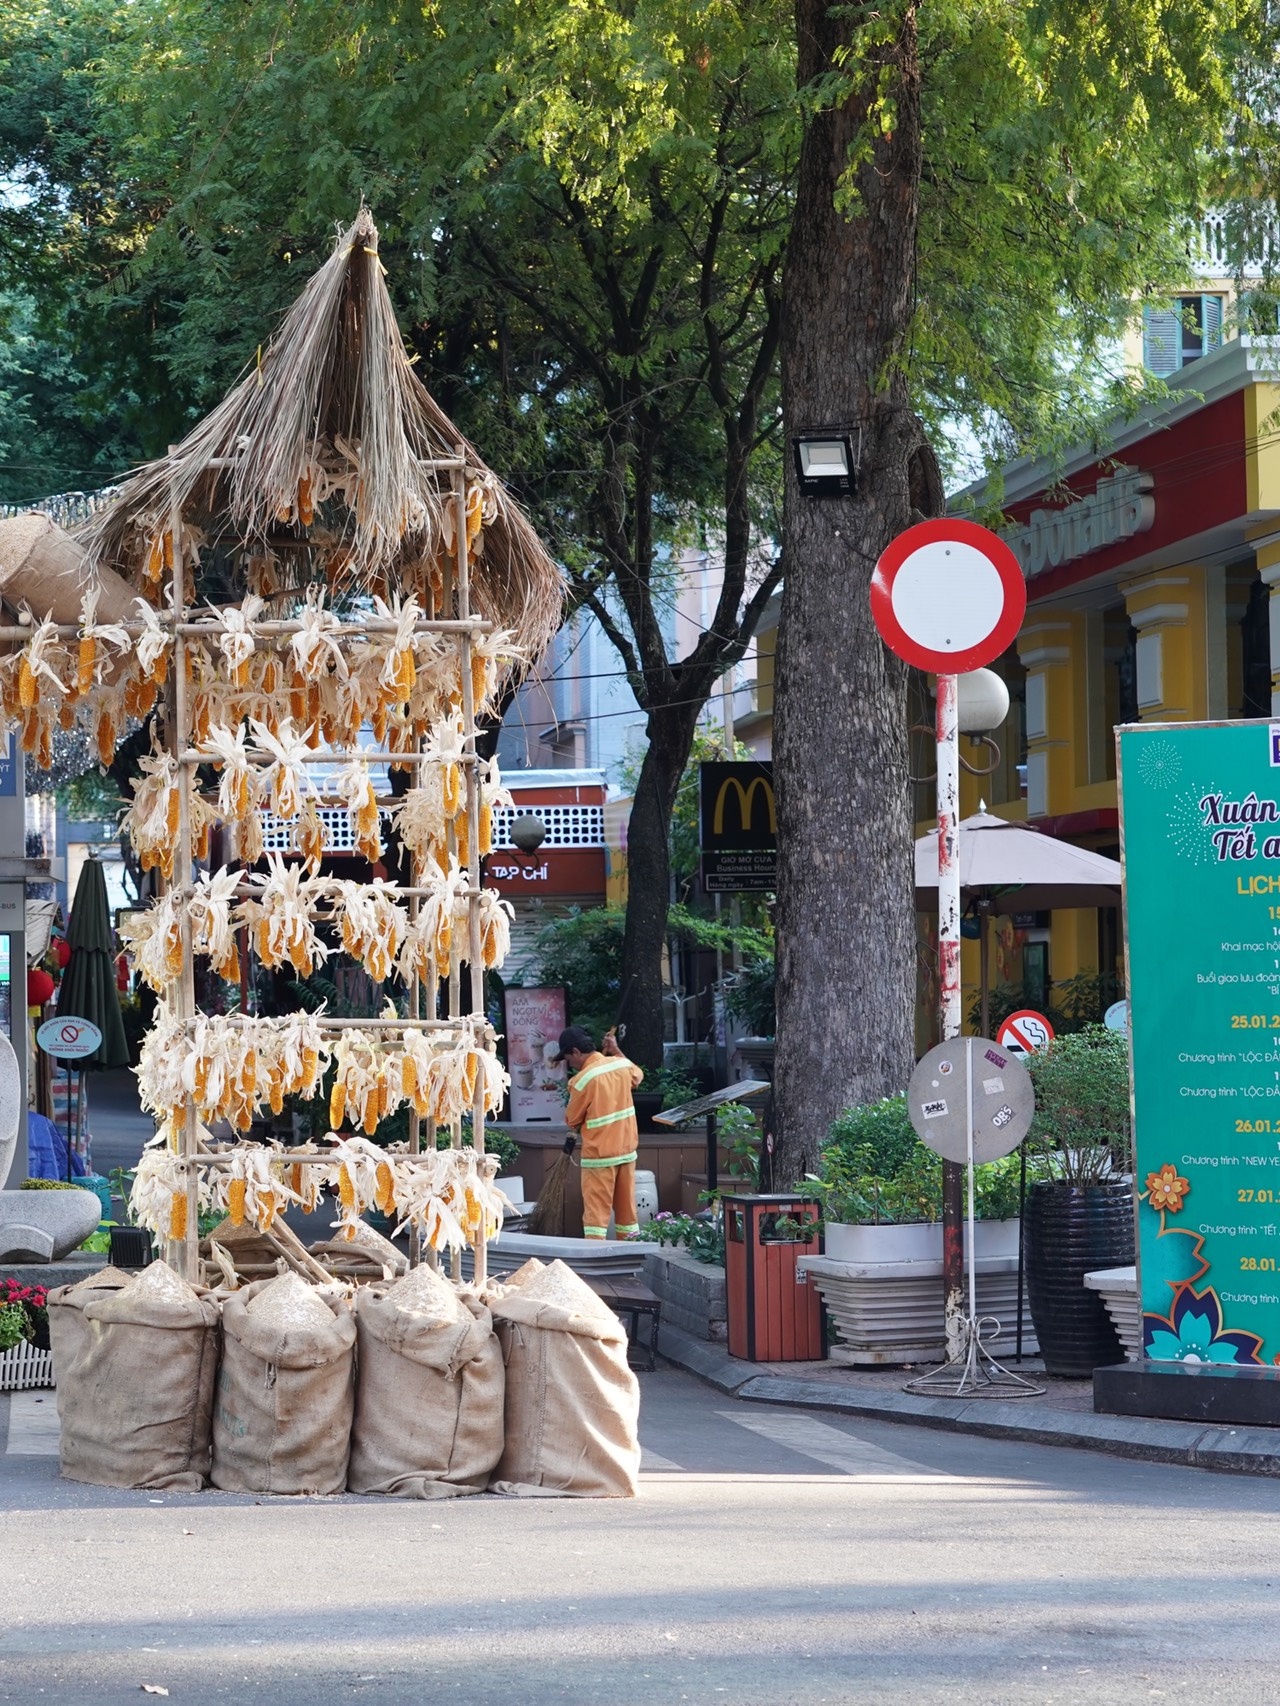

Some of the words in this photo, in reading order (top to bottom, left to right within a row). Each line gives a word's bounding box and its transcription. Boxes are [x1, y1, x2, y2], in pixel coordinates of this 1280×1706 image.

[1199, 791, 1280, 826] Xuân
[1212, 824, 1259, 862] Tết
[522, 862, 549, 880] CHÍ
[1221, 942, 1241, 952] Khai
[1243, 942, 1265, 952] mạc
[1197, 971, 1216, 984] Buổi
[1218, 974, 1239, 985] giao
[1240, 973, 1254, 983] lưu
[1178, 1053, 1215, 1065] Chương
[1217, 1052, 1236, 1062] trình
[1180, 1086, 1217, 1099] Chương
[1218, 1086, 1237, 1096] trình
[1181, 1155, 1218, 1167] Chương
[1220, 1155, 1239, 1165] trình
[1199, 1223, 1236, 1237] Chương
[1238, 1224, 1257, 1235] trình
[1220, 1291, 1257, 1305] Chương
[1260, 1294, 1279, 1303] trình
